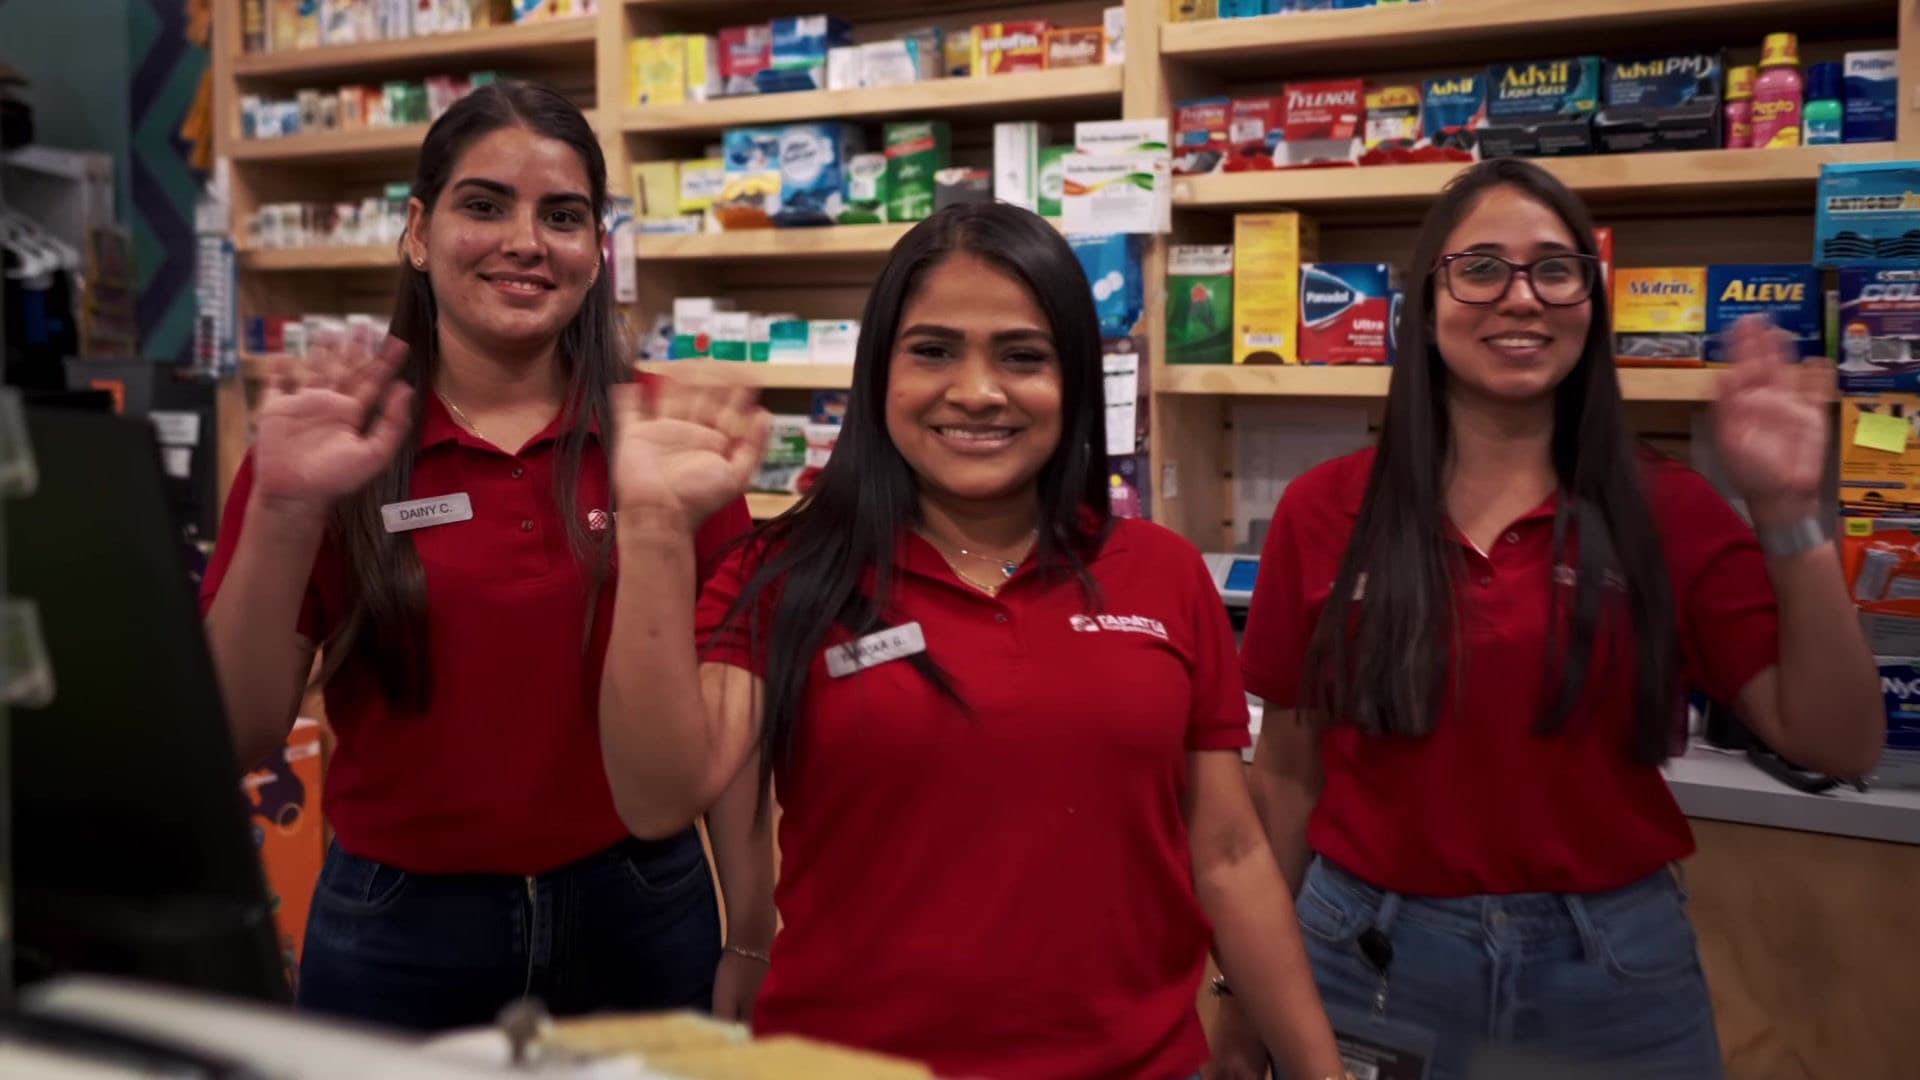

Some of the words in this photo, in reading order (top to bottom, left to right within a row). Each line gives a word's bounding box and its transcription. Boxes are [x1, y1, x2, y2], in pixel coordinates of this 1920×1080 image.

[1503, 62, 1569, 87] Advil
[1614, 60, 1664, 79] Advil
[1665, 57, 1700, 75] PM
[1431, 78, 1475, 96] Advil
[1287, 91, 1358, 109] TYLENOL
[1306, 291, 1349, 303] Panadol
[1720, 280, 1805, 301] ALEVE
[400, 505, 437, 521] DAINY
